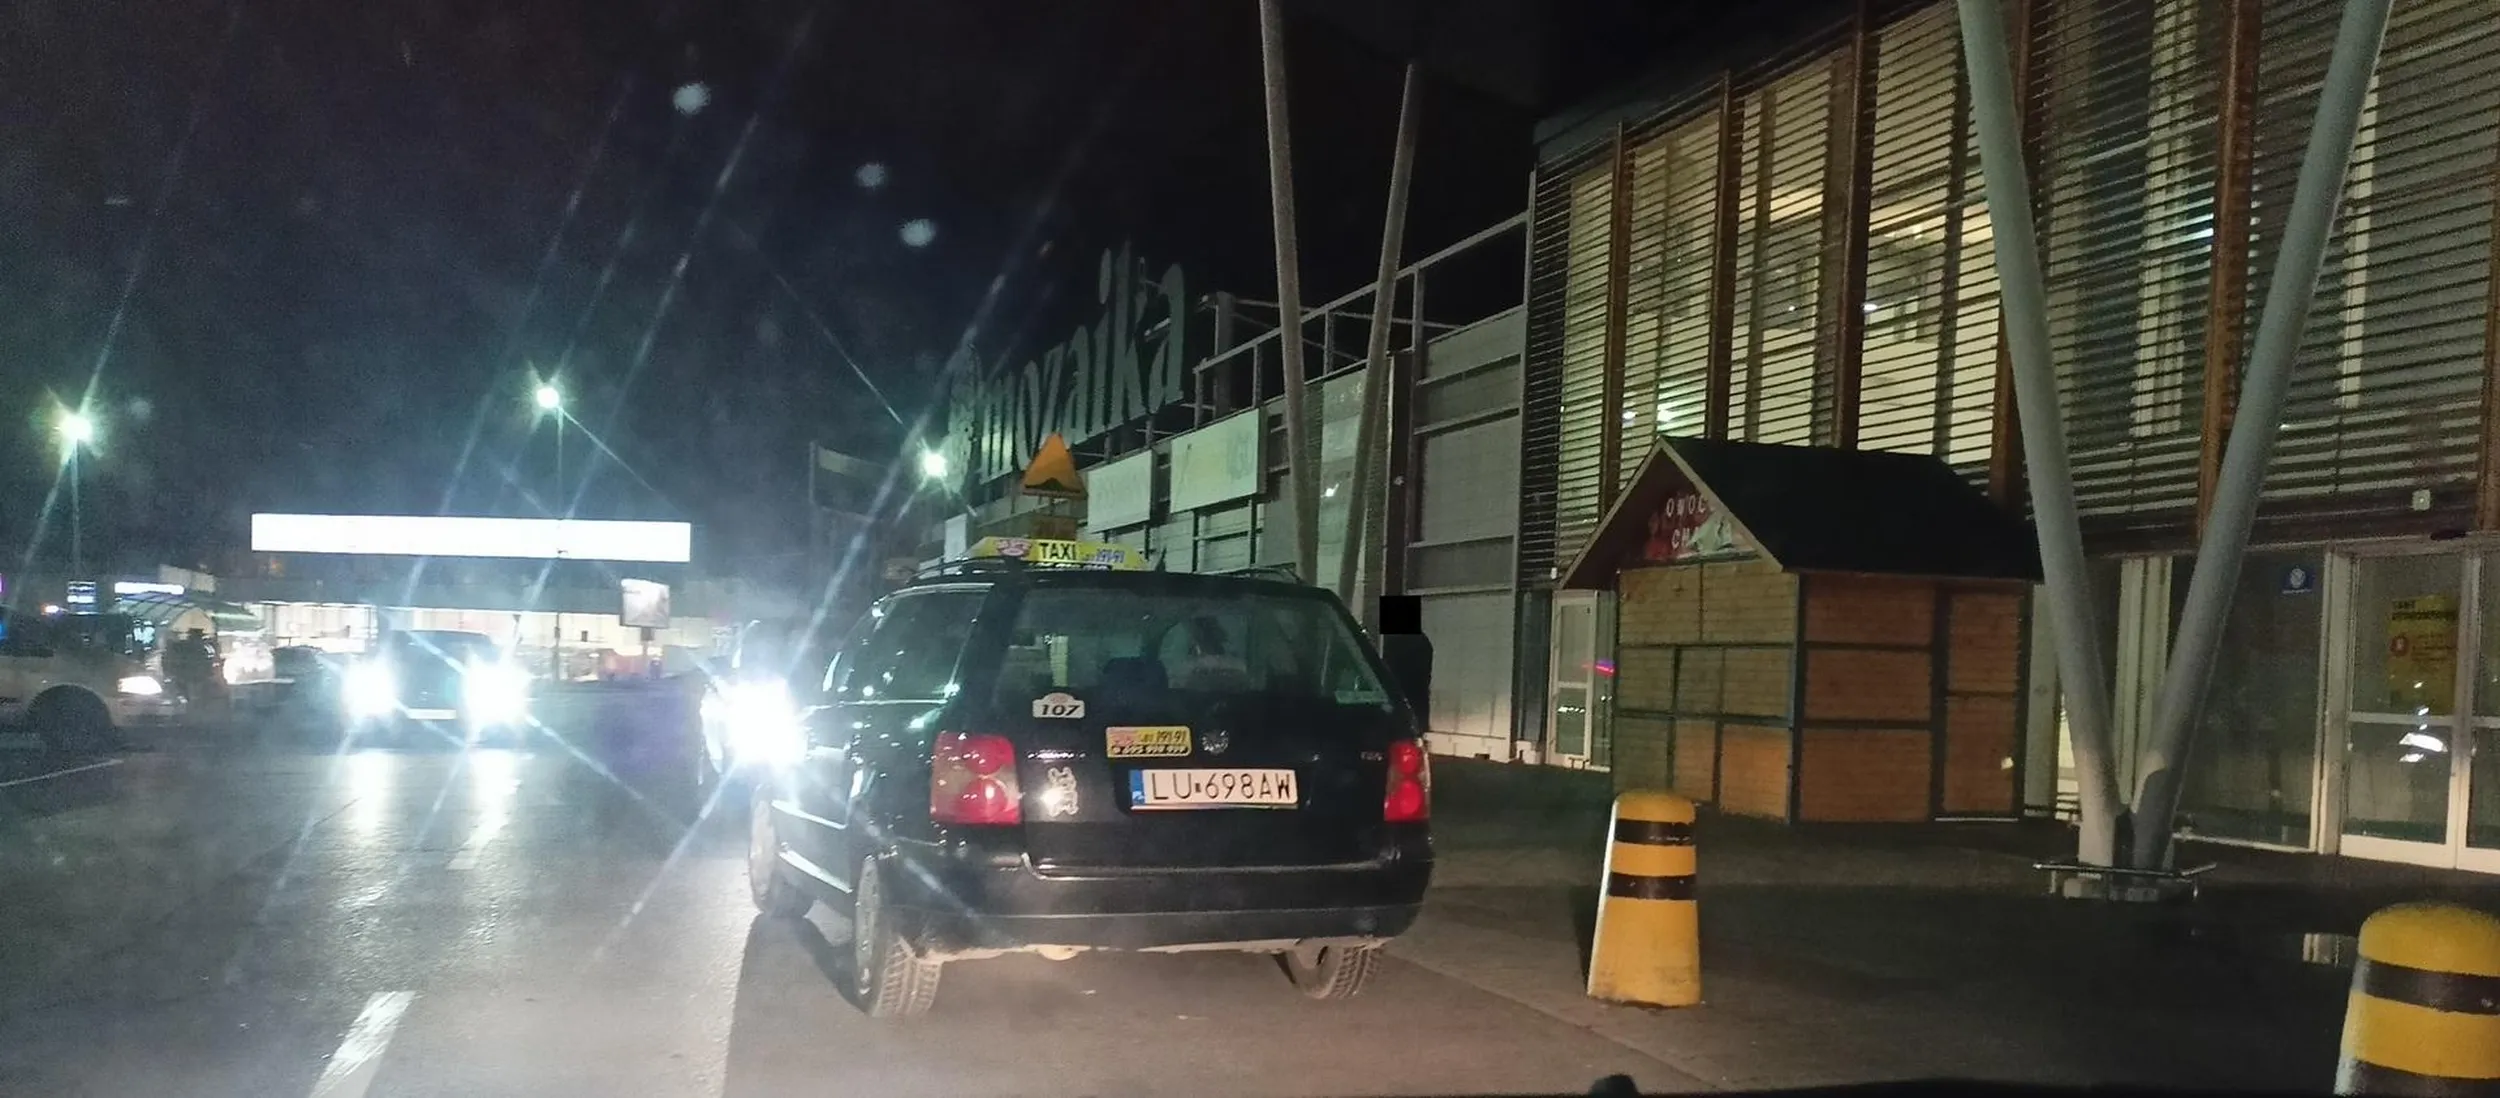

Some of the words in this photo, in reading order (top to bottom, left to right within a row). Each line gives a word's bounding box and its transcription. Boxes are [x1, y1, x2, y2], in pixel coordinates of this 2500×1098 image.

[980, 238, 1184, 484] mozaika
[1039, 542, 1076, 560] TAXI
[1041, 704, 1080, 716] 107
[1151, 772, 1192, 800] LU
[1204, 772, 1291, 800] 698AW
